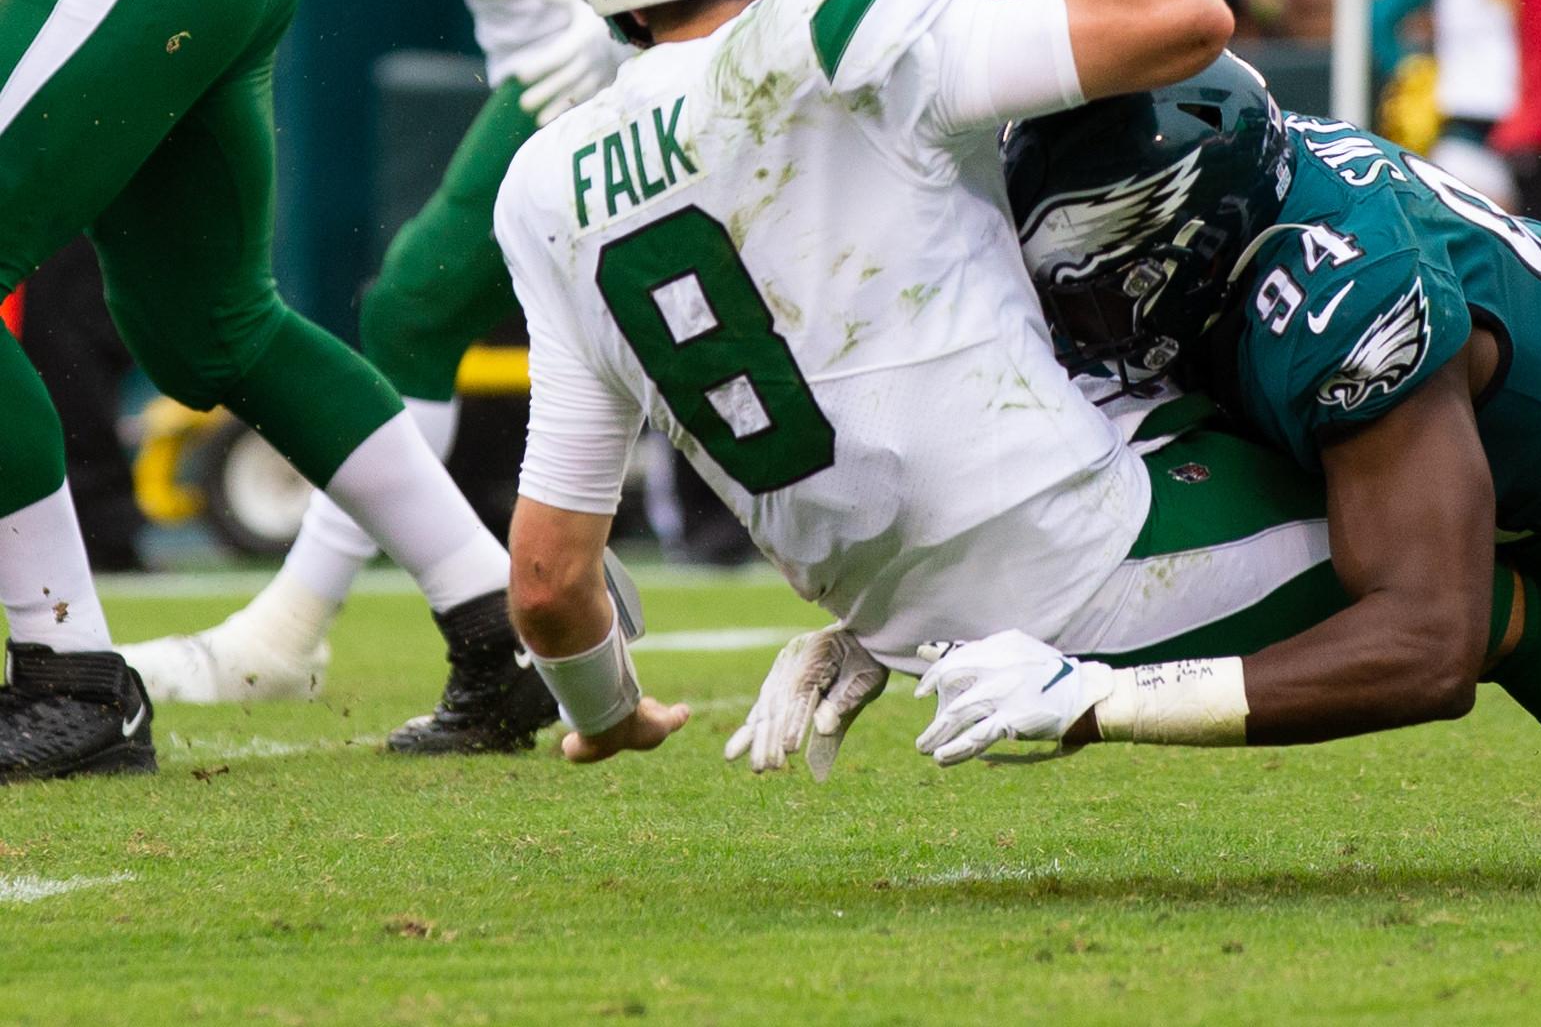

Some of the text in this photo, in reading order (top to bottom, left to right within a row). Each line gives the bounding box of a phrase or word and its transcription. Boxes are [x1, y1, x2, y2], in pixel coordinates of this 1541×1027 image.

[572, 94, 699, 229] FALK
[1253, 222, 1367, 335] 94
[595, 203, 836, 496] 8
